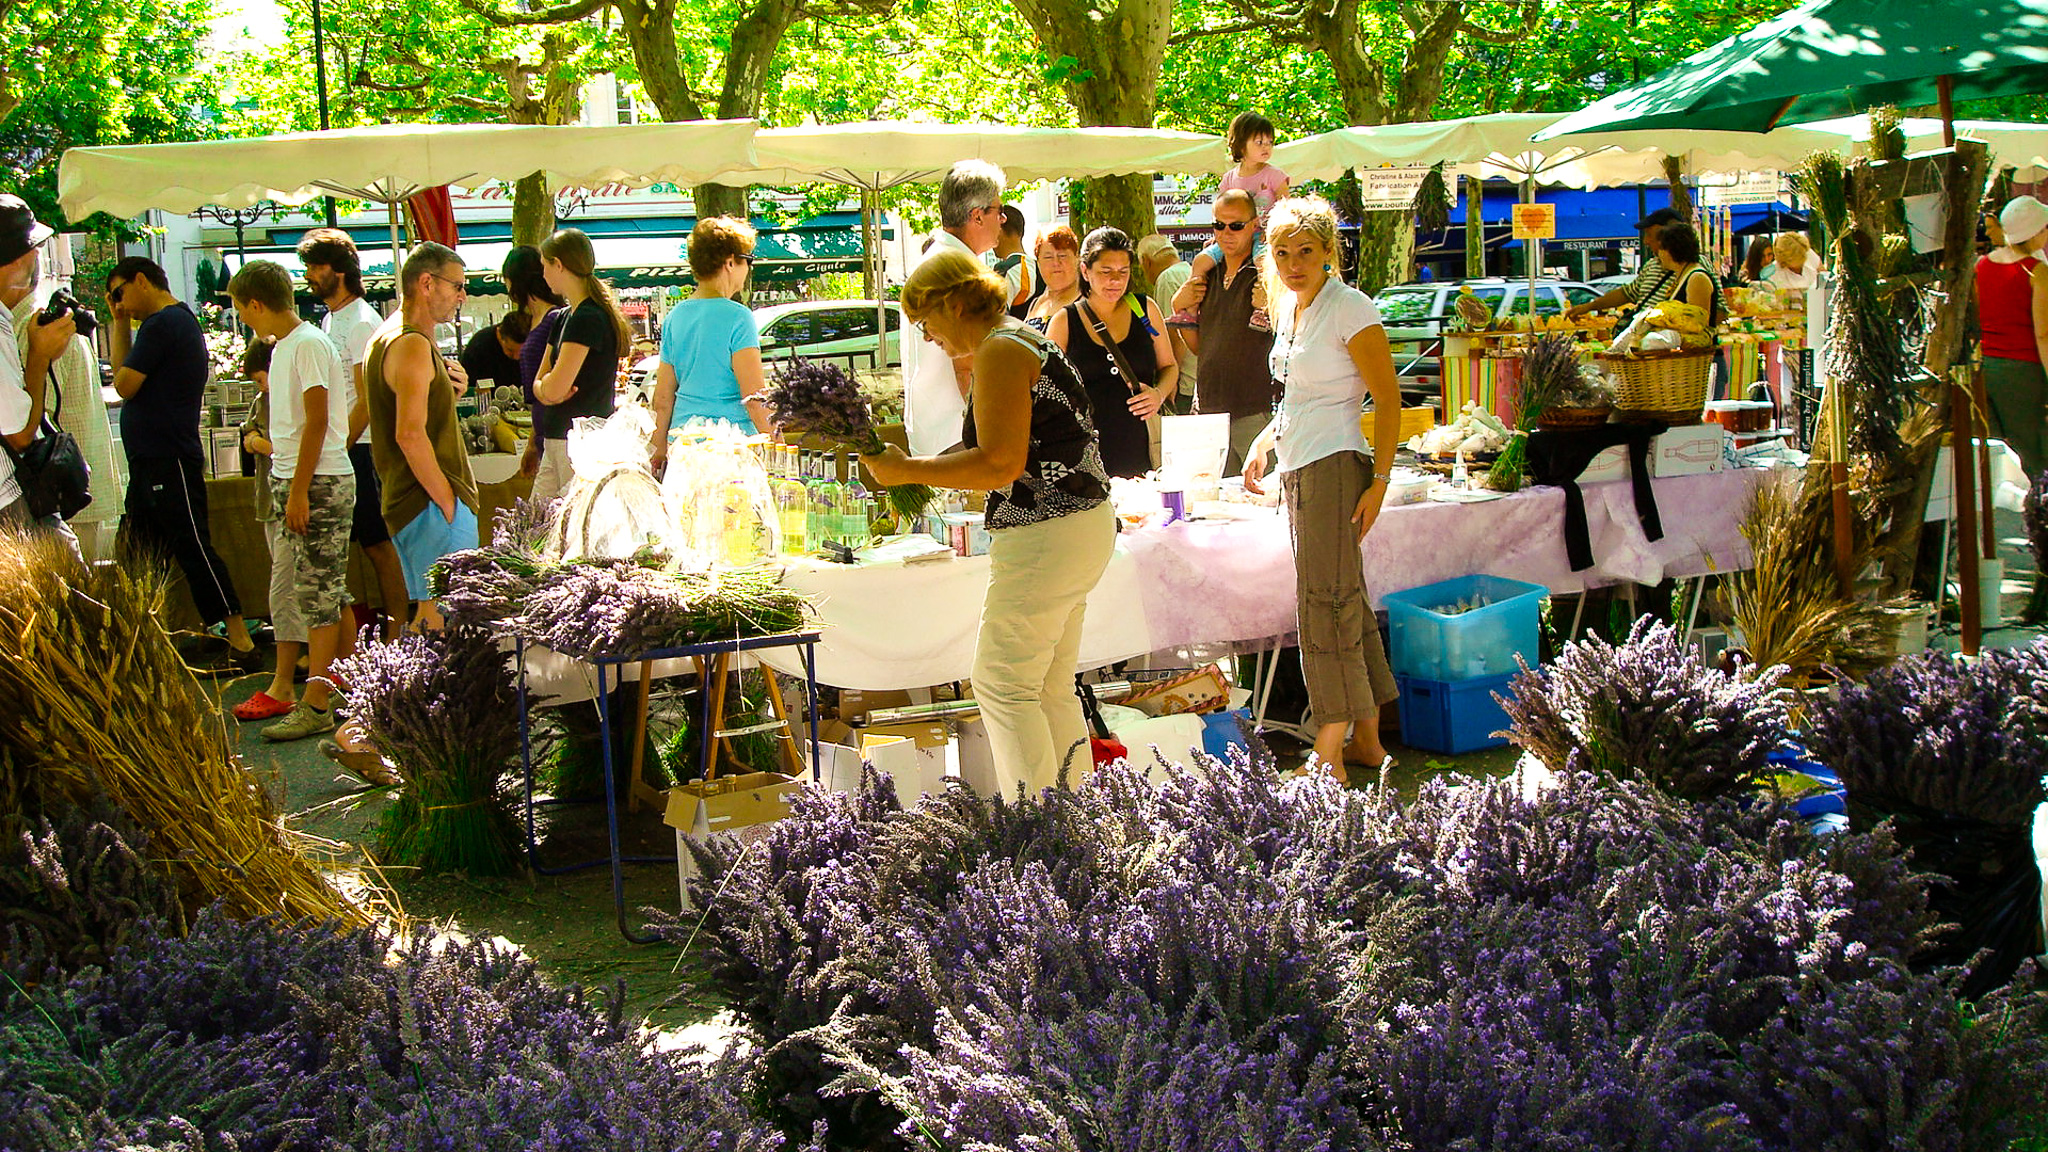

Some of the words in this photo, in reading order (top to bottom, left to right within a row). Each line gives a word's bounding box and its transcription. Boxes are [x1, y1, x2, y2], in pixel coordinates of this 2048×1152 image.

[1154, 194, 1212, 205] MMOBERE
[1179, 232, 1215, 242] IMMOBI
[1563, 241, 1608, 250] RESTAURANT
[1620, 240, 1640, 248] GLAC
[629, 267, 690, 278] PIZZ
[772, 265, 793, 275] La
[804, 261, 846, 273] Cigale
[1802, 350, 1812, 395] Templiers
